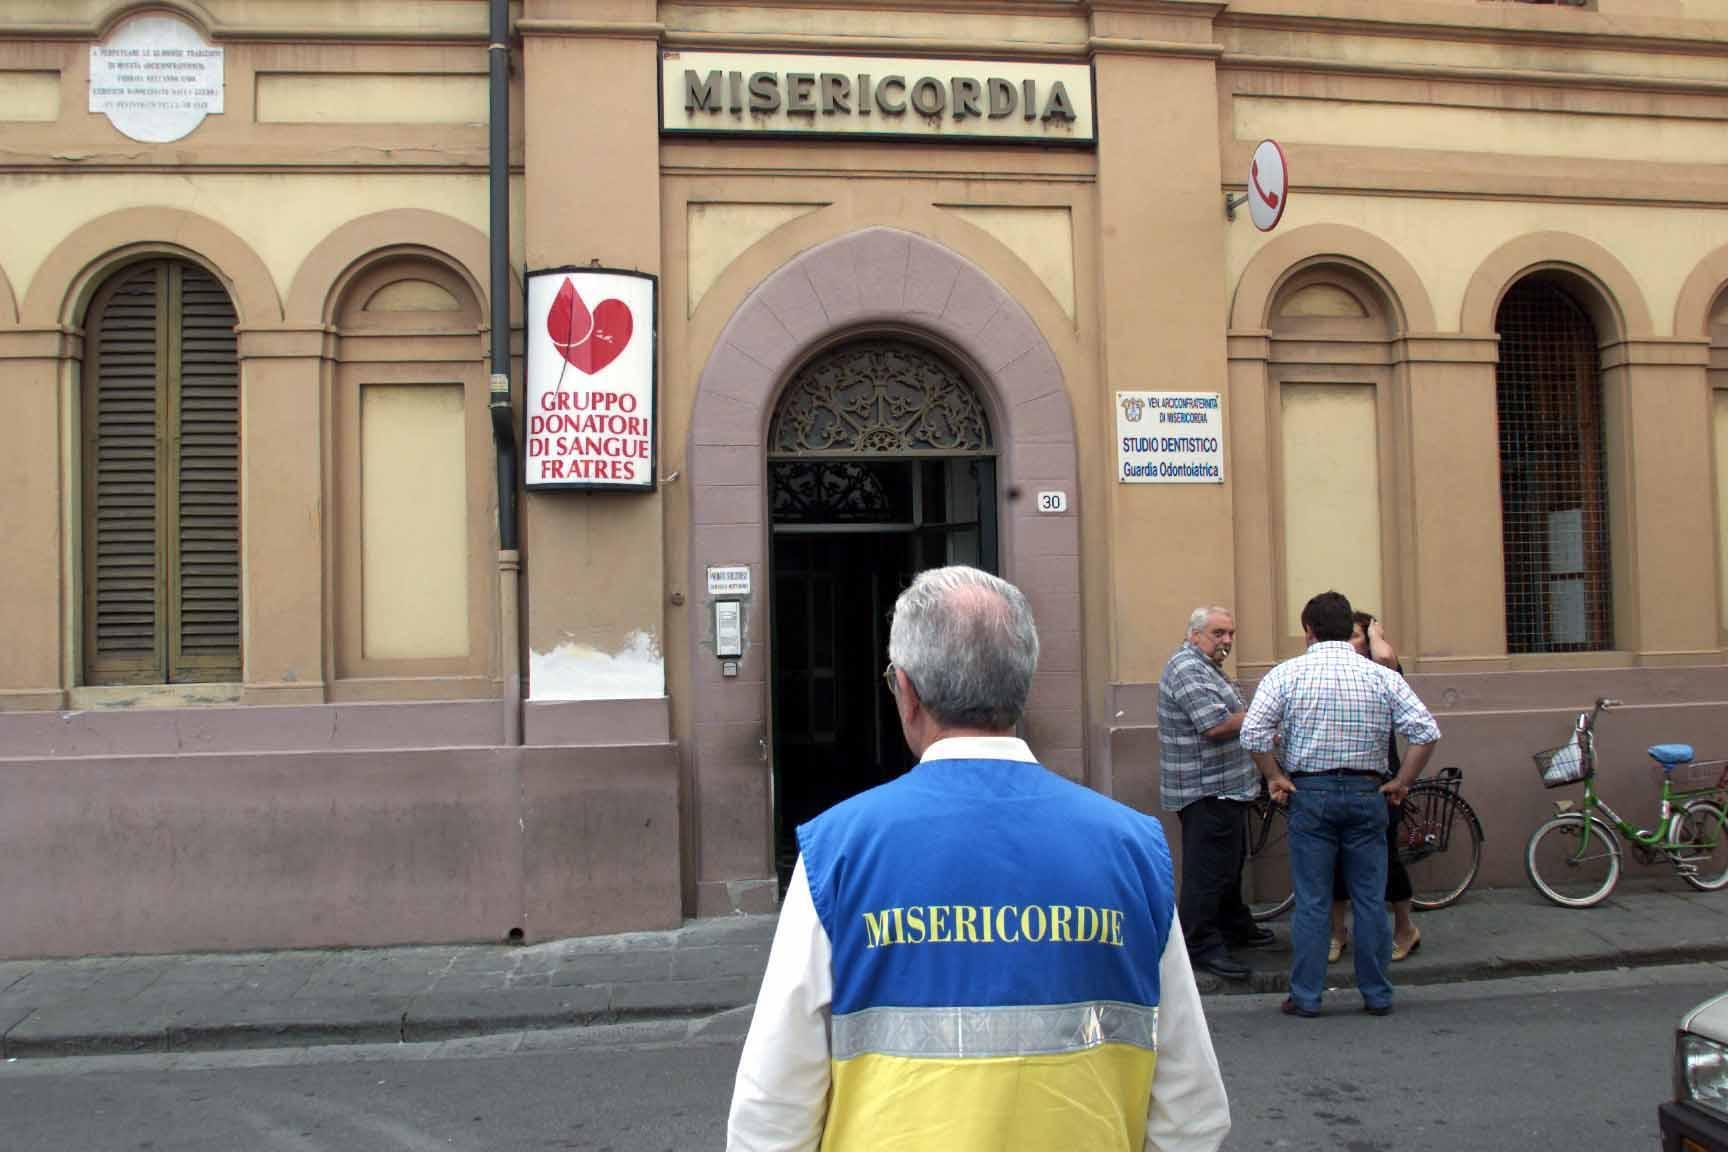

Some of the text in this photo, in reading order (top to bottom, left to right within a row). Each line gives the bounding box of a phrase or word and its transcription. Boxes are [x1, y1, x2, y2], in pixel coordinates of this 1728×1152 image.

[684, 68, 1077, 122] MISERICORDIA
[541, 391, 637, 413] GRUPPO
[531, 414, 648, 437] DONATORI
[529, 436, 649, 459] DI SANGUE
[1123, 438, 1218, 453] STUDIO DENTISTICO
[541, 459, 635, 480] FRATRES
[1123, 461, 1219, 477] Guardia Odontoiatrica
[1042, 495, 1061, 509] 30
[862, 904, 1125, 949] MISERICORDIE
